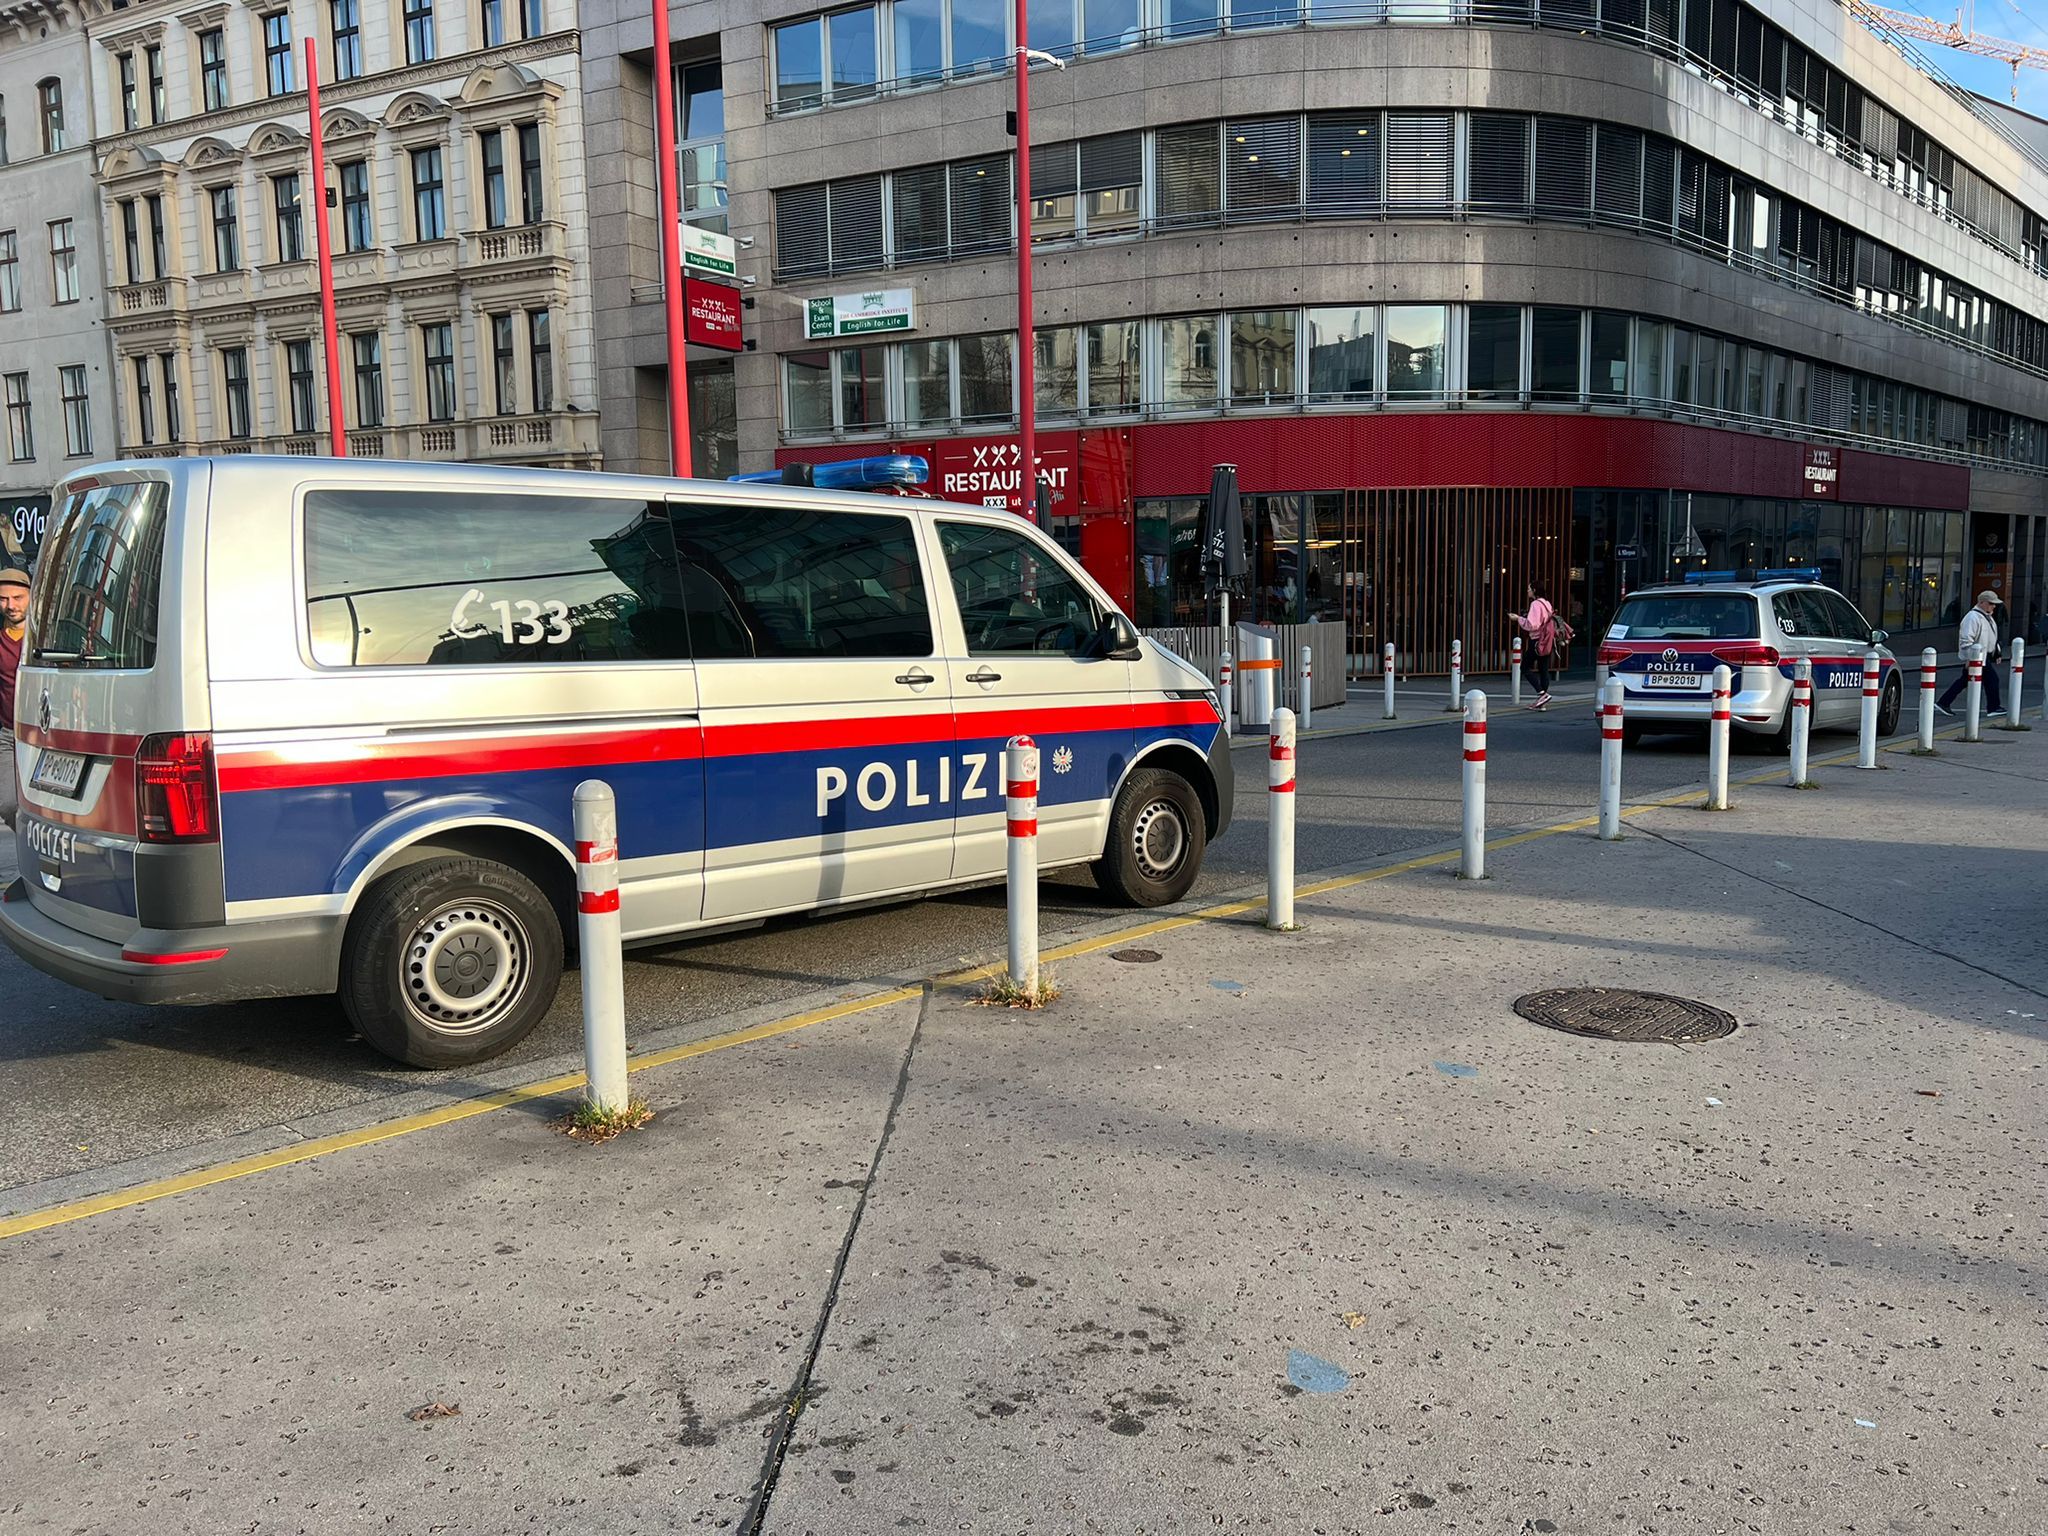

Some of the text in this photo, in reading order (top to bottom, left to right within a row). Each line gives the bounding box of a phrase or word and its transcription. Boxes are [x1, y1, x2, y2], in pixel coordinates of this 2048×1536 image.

[690, 254, 729, 270] English for Life
[701, 297, 727, 313] XXXL
[811, 299, 832, 308] School
[691, 306, 736, 325] RESTAURANT
[811, 321, 833, 330] Centre
[847, 317, 901, 331] English for Life
[1804, 465, 1837, 482] RESTAURANT
[985, 498, 1005, 507] XXX
[490, 599, 572, 645] 133
[1782, 619, 1795, 633] 133
[1647, 662, 1695, 671] POLIZEI
[1651, 675, 1696, 686] BP 92018
[1829, 672, 1862, 688] POLIZEI
[27, 819, 77, 864] POLIZEI
